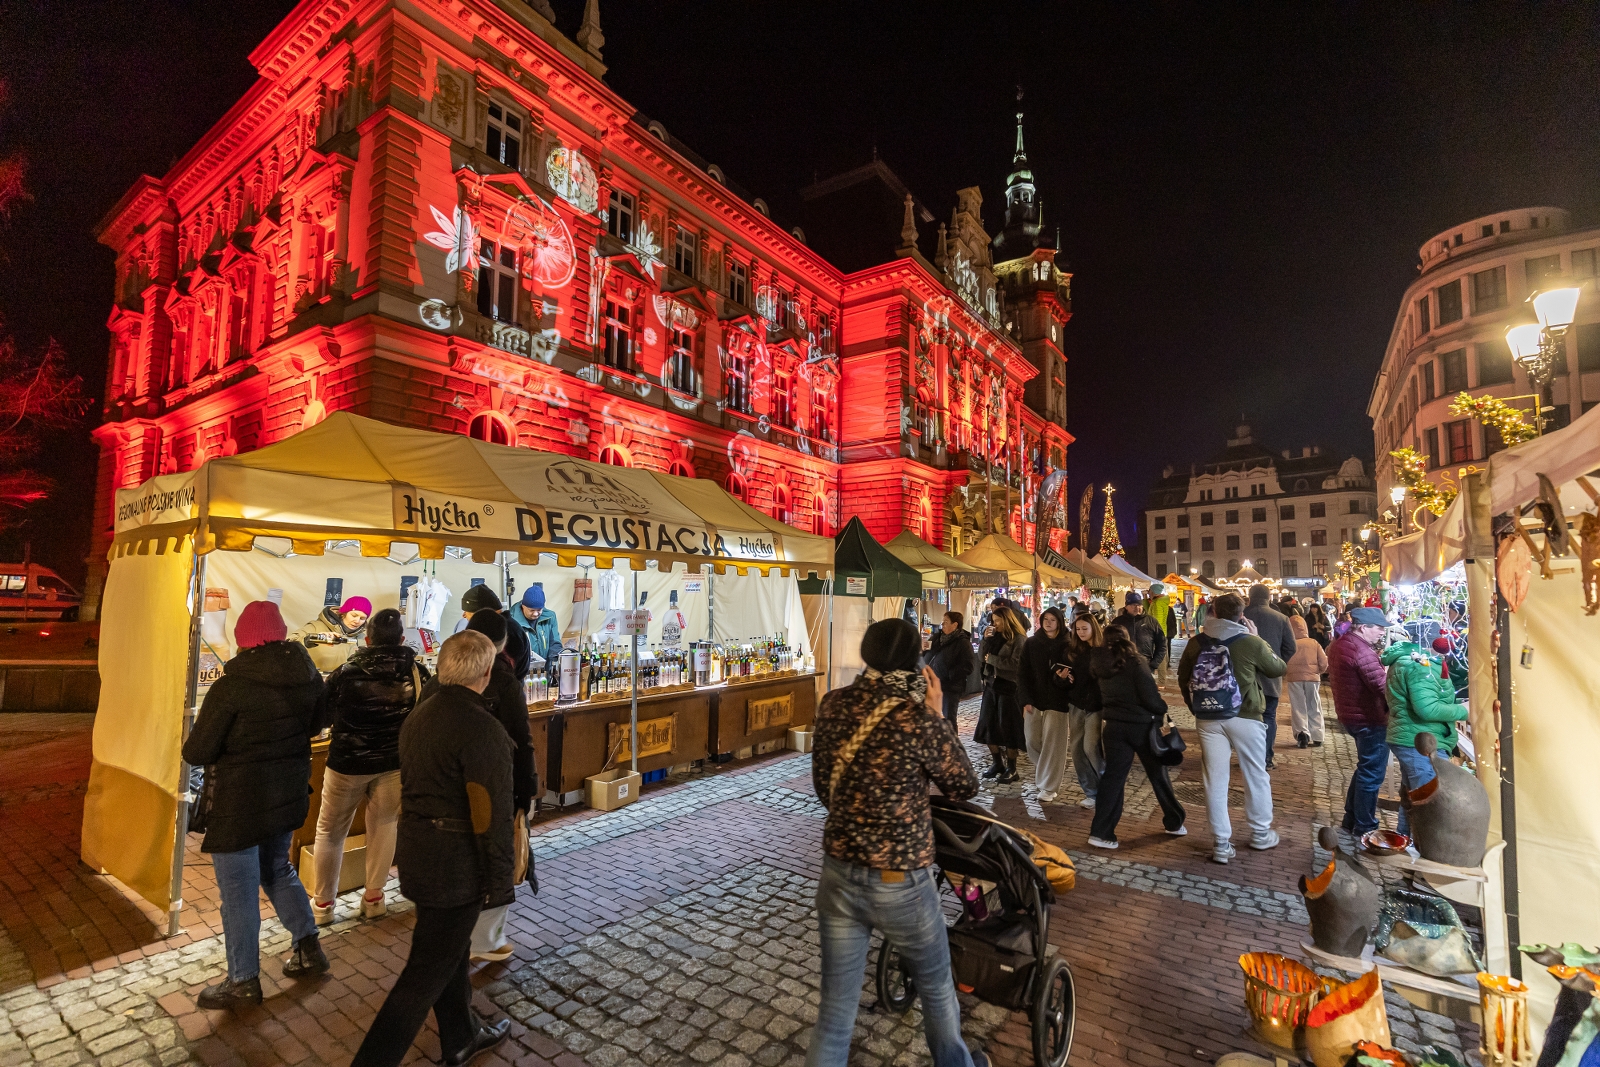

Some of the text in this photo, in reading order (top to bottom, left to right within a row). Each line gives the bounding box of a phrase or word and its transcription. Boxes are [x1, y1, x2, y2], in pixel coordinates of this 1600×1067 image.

[147, 491, 175, 513] POLSKIE
[175, 486, 196, 508] WINA
[546, 484, 653, 505] ALKOHOLE
[515, 506, 732, 557] DEGUSTACJA
[200, 668, 225, 682] yćk
